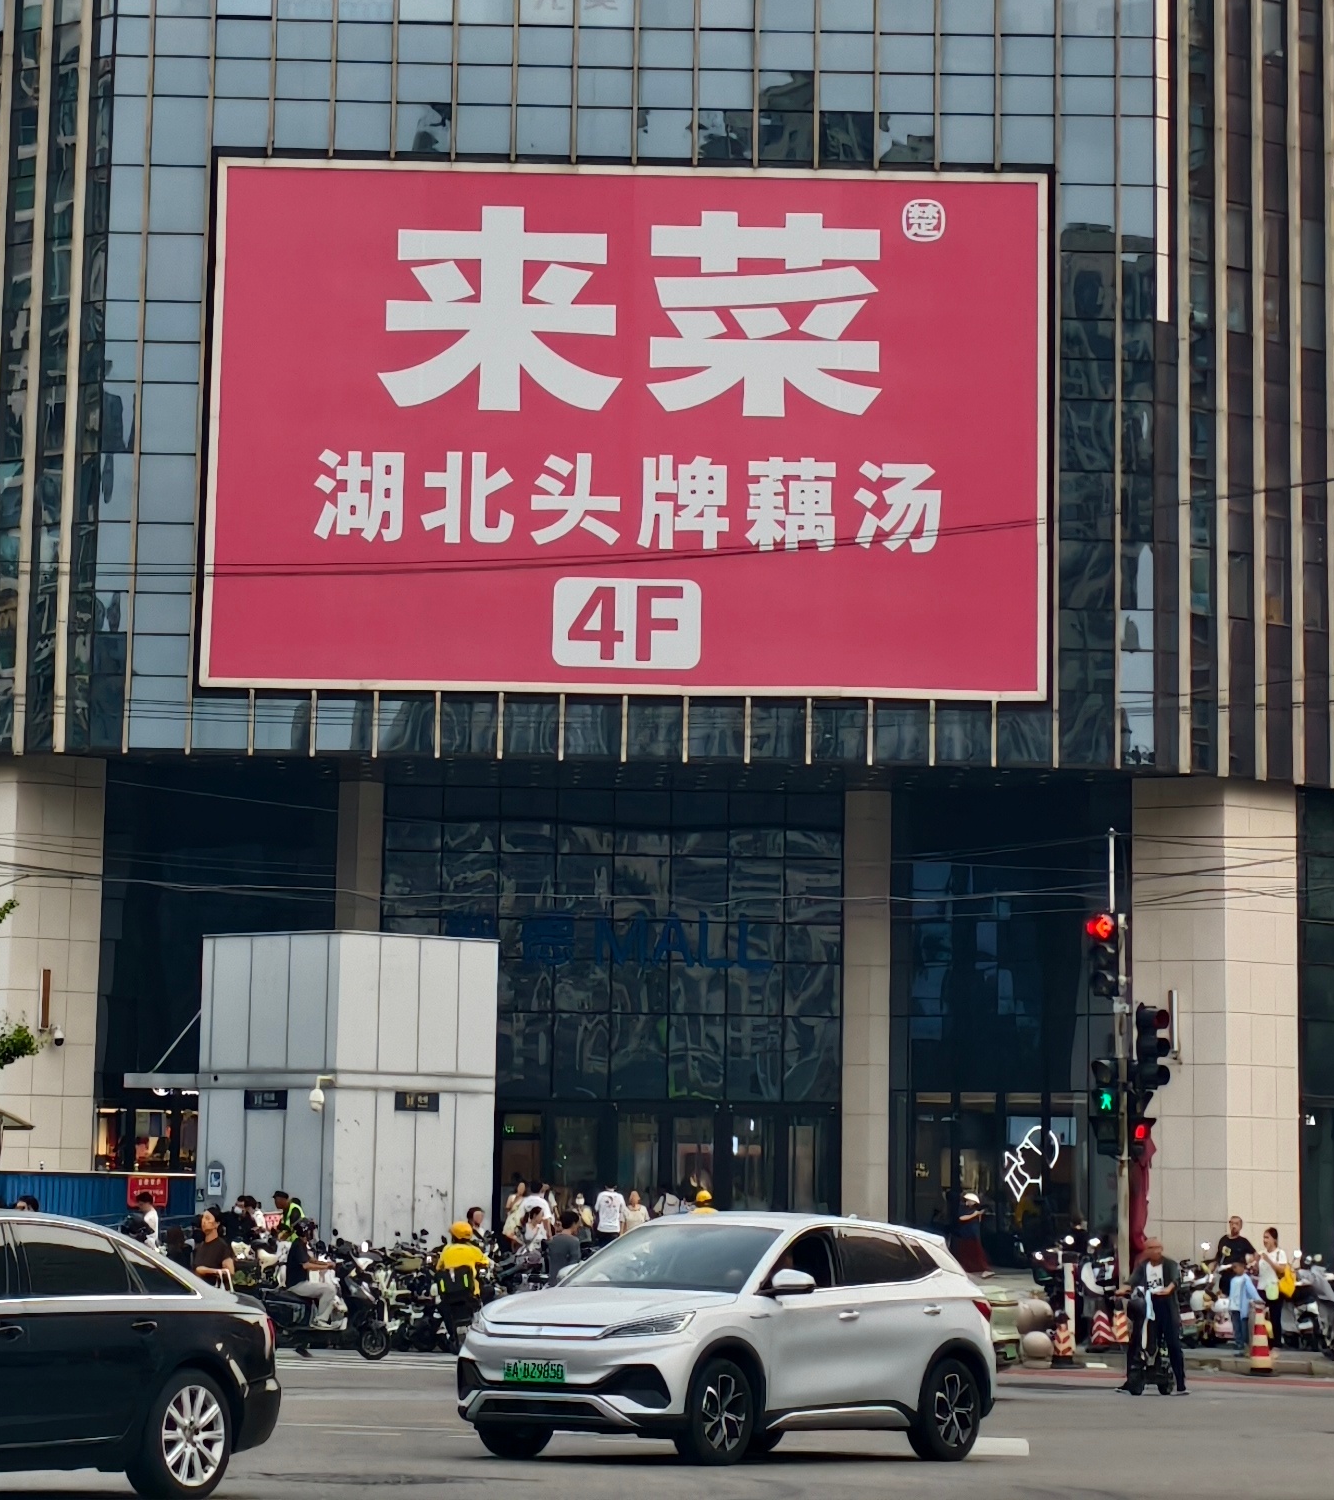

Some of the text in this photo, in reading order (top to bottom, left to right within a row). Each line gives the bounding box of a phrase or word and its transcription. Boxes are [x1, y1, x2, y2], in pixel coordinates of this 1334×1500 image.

[378, 205, 883, 416] 来菜
[314, 448, 943, 554] 湖北头牌藕汤
[566, 586, 685, 661] 4F
[594, 911, 773, 968] MALL
